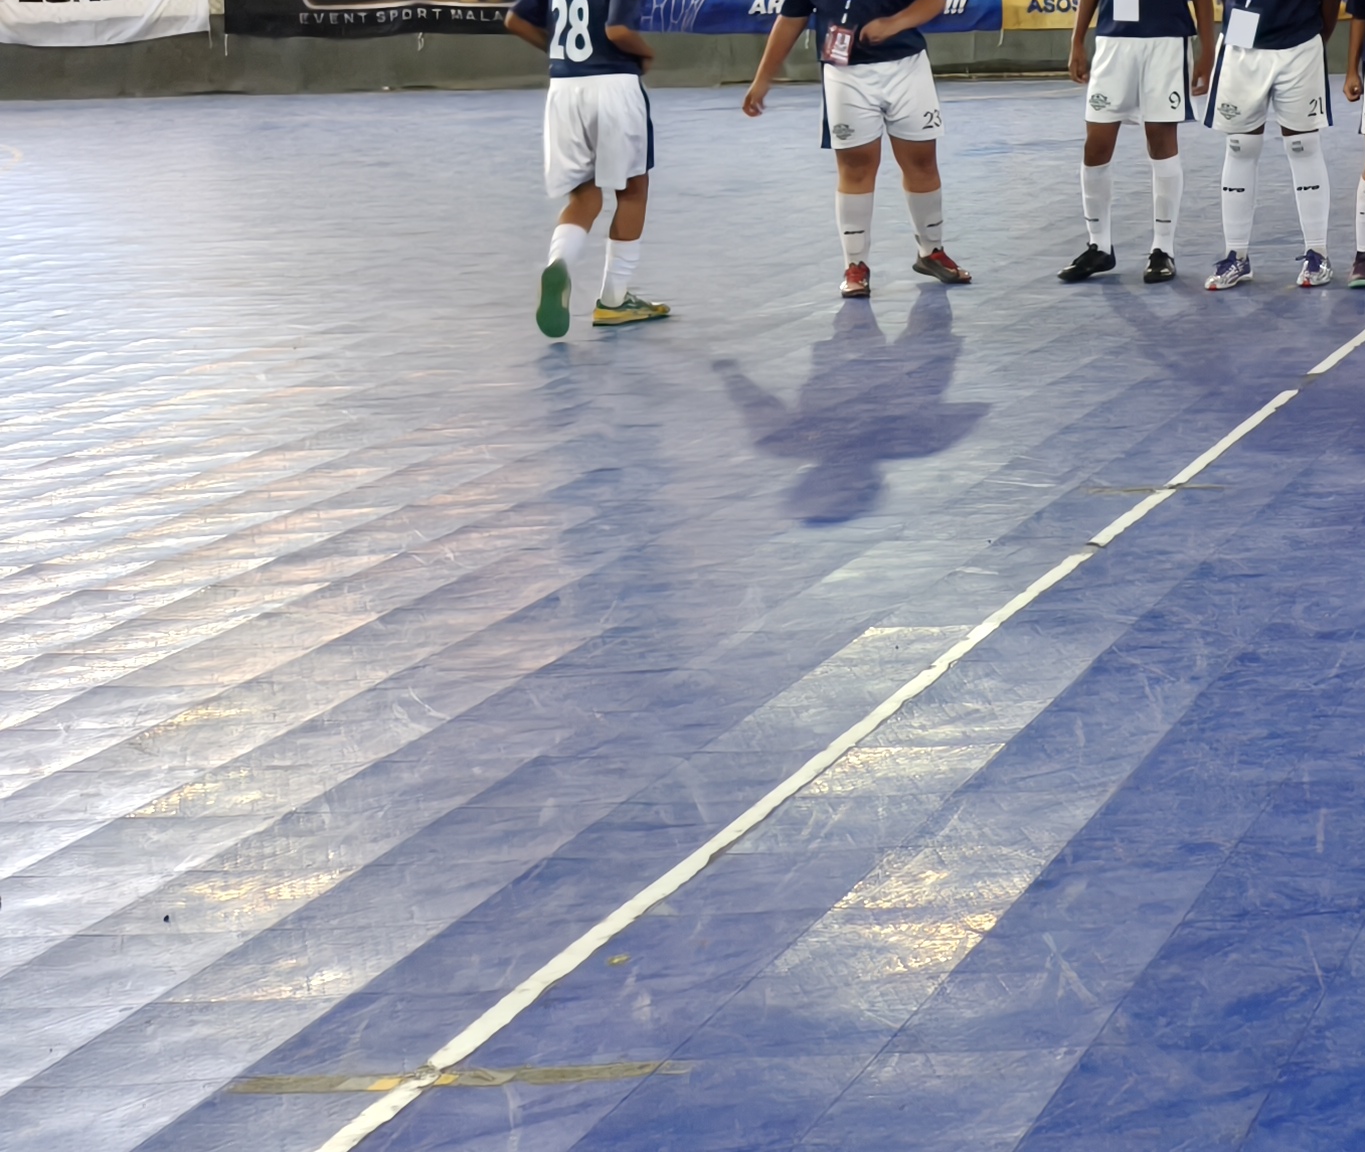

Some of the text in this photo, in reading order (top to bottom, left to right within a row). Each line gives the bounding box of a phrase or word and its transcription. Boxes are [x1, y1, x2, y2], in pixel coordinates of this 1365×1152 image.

[300, 8, 504, 25] EVENT SPORT MALA
[1168, 91, 1182, 110] 9
[1308, 97, 1324, 117] 21
[921, 109, 942, 130] 23
